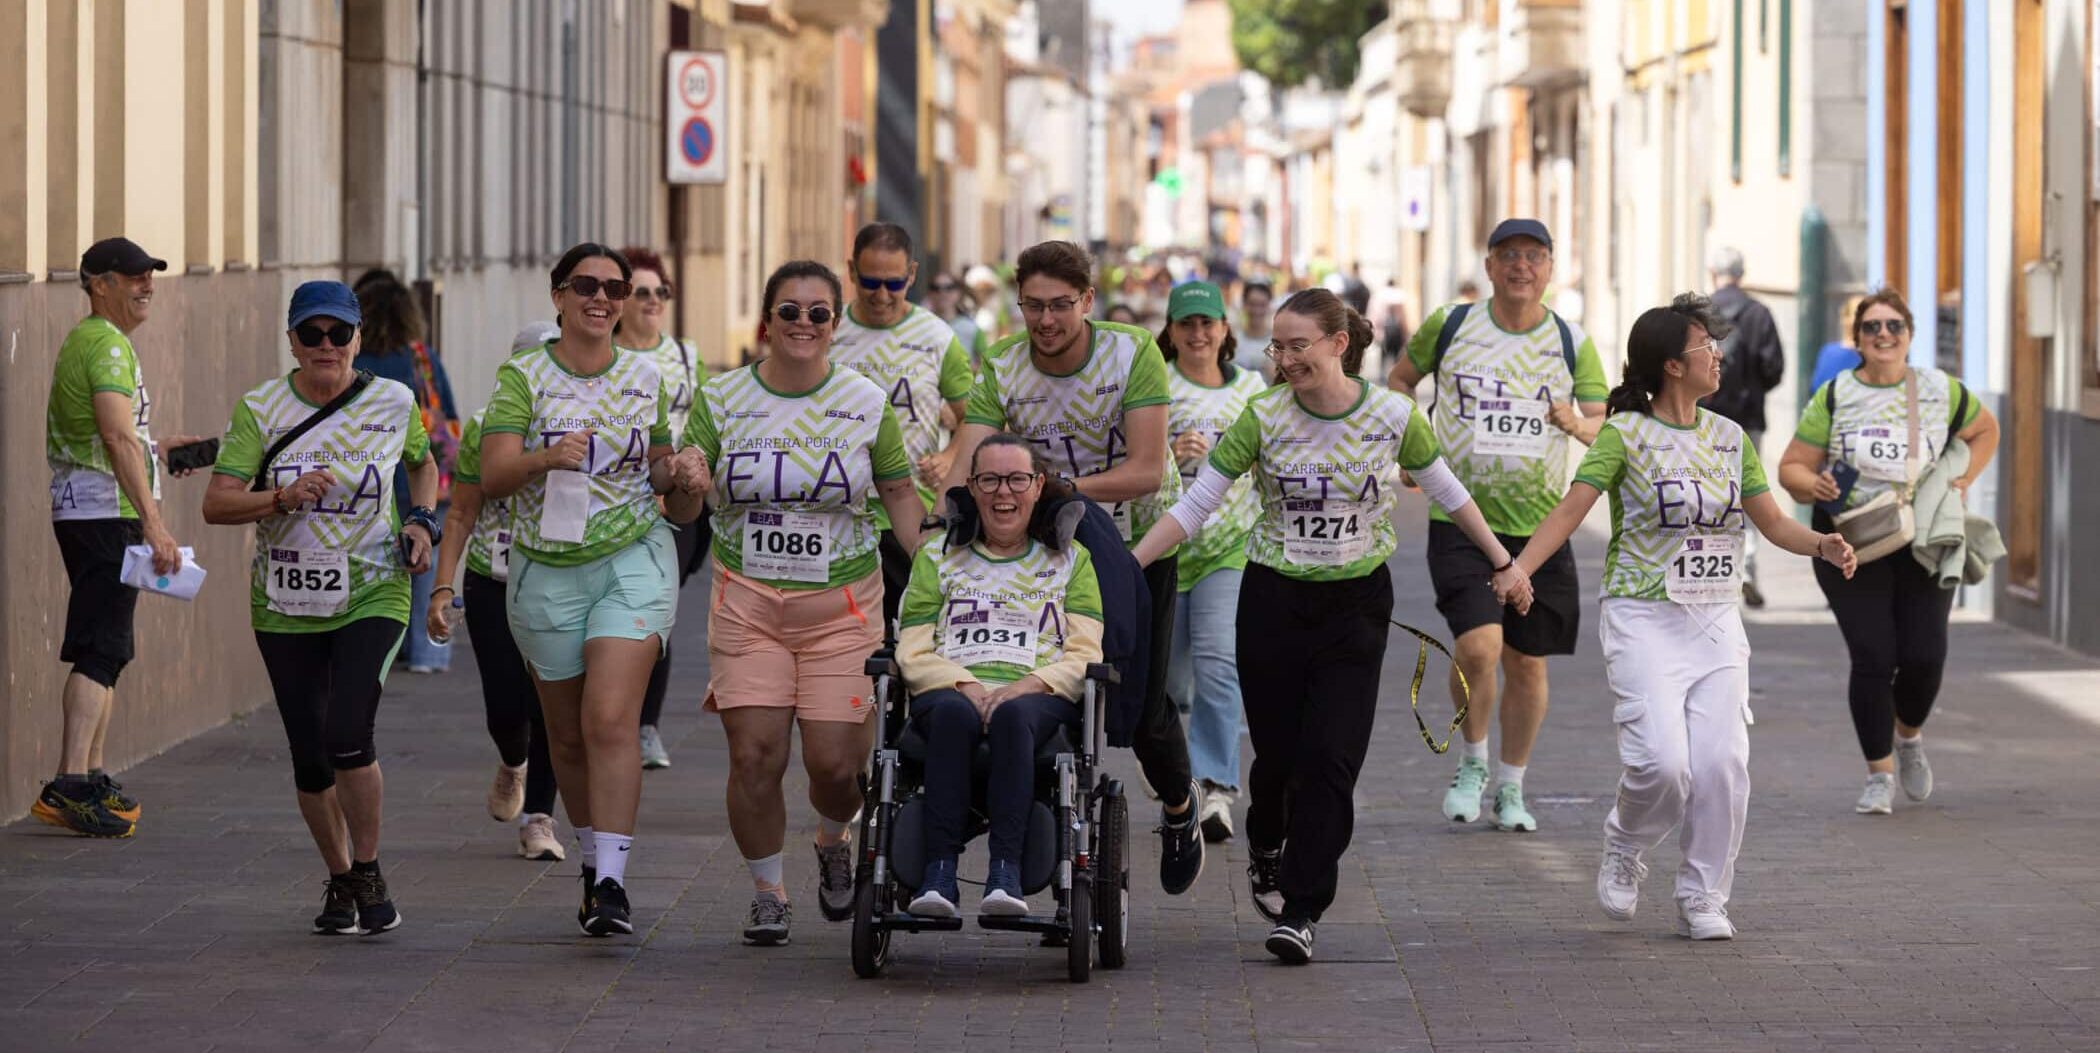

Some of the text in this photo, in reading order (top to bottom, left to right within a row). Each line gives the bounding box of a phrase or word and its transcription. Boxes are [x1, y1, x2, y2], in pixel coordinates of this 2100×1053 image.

[549, 417, 606, 429] CARRERA
[609, 414, 632, 426] POR
[824, 409, 865, 422] ISSLA
[1084, 415, 1109, 430] POR
[361, 423, 397, 433] ISSLA
[1482, 414, 1543, 436] 1679
[738, 437, 801, 450] CARRERA
[805, 437, 831, 448] POR
[834, 438, 849, 449] LA
[1361, 432, 1397, 442] ISSLA
[280, 450, 386, 463] CARRERA POR LA
[1026, 425, 1127, 478] LA
[1283, 462, 1342, 474] CARRERA
[1345, 461, 1369, 473] POR
[1372, 460, 1384, 471] LA
[727, 451, 851, 504] ELA
[1652, 480, 1745, 530] ELA
[757, 513, 775, 524] ELA
[1293, 514, 1359, 540] 1274
[751, 529, 823, 557] 1086
[1673, 555, 1733, 578] 1325
[274, 566, 342, 591] 1852
[1021, 590, 1046, 600] POR
[946, 599, 1064, 646] EA
[960, 610, 980, 622] ELA
[955, 628, 1027, 647] 1031
